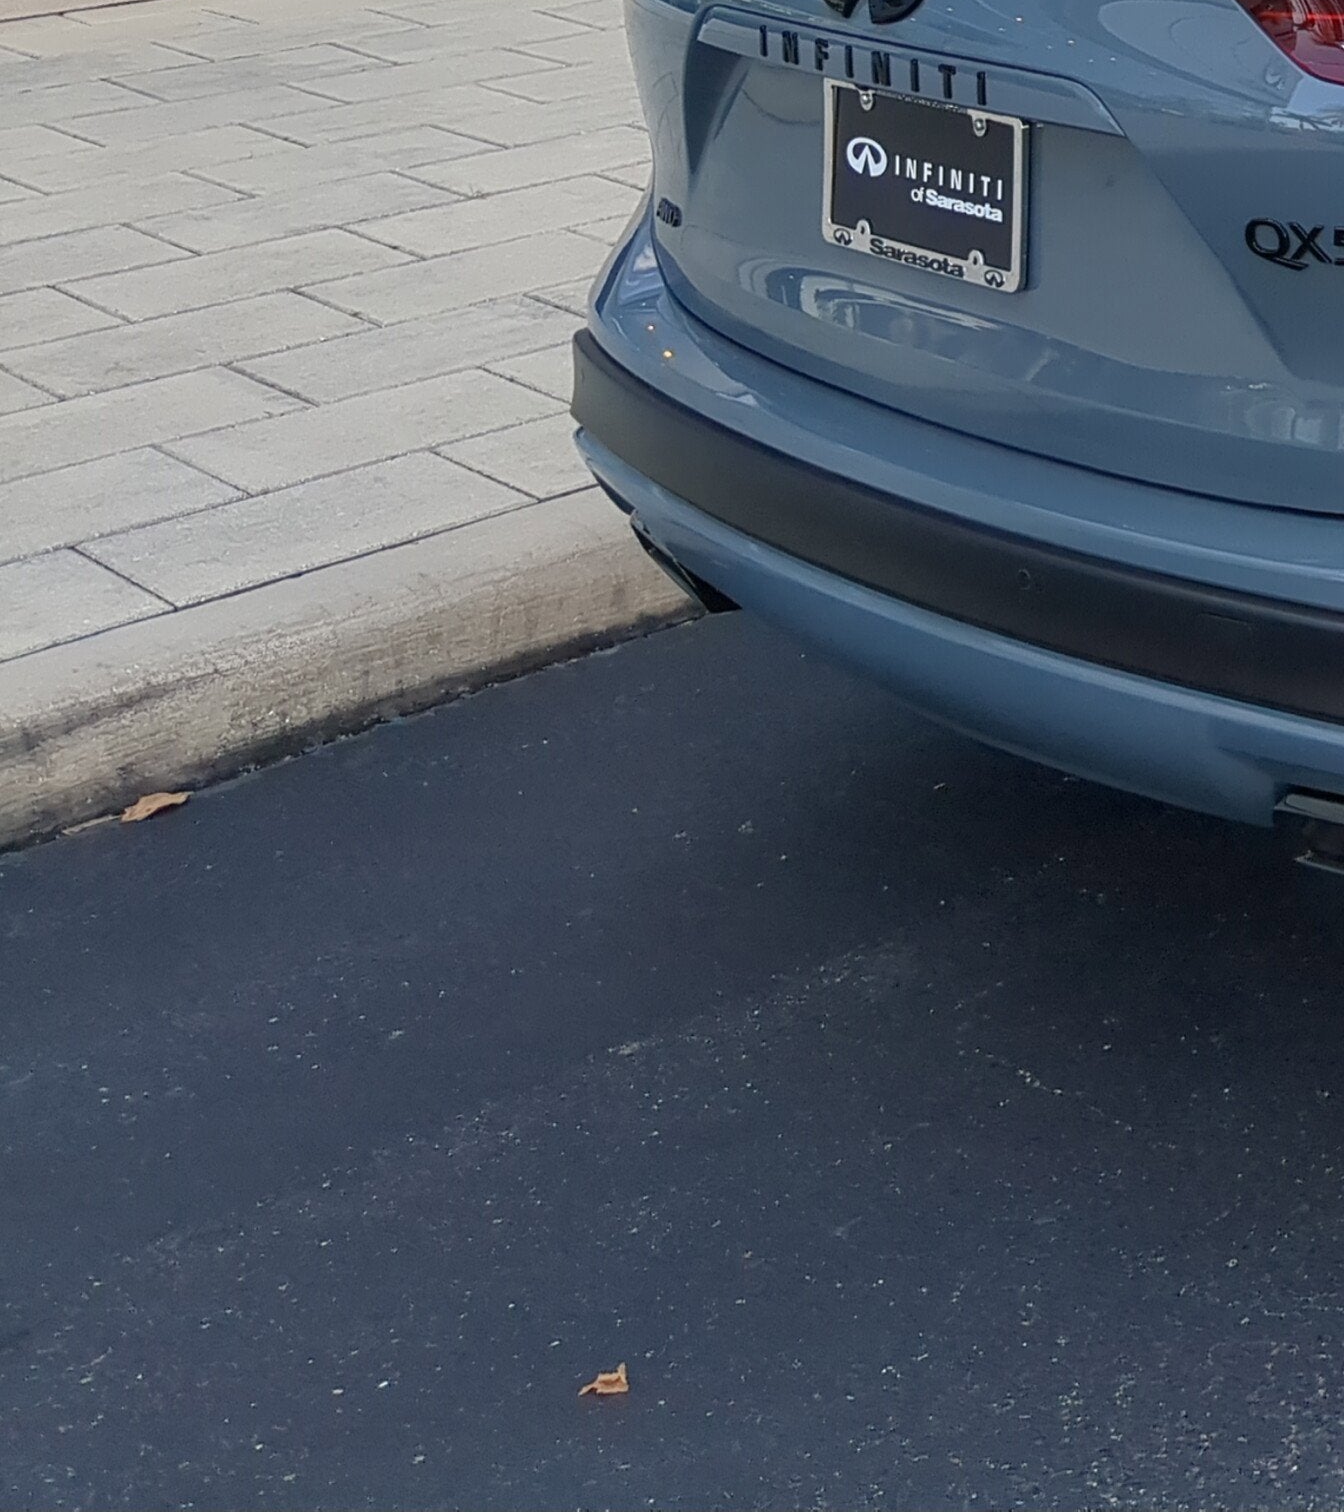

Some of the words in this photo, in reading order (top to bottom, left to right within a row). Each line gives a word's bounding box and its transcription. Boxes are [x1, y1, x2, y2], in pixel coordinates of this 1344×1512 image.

[759, 25, 987, 106] INFINITI
[895, 155, 1003, 200] INFINITI
[910, 187, 924, 203] of
[925, 189, 1003, 223] Sarasota
[869, 238, 964, 279] Sarasota
